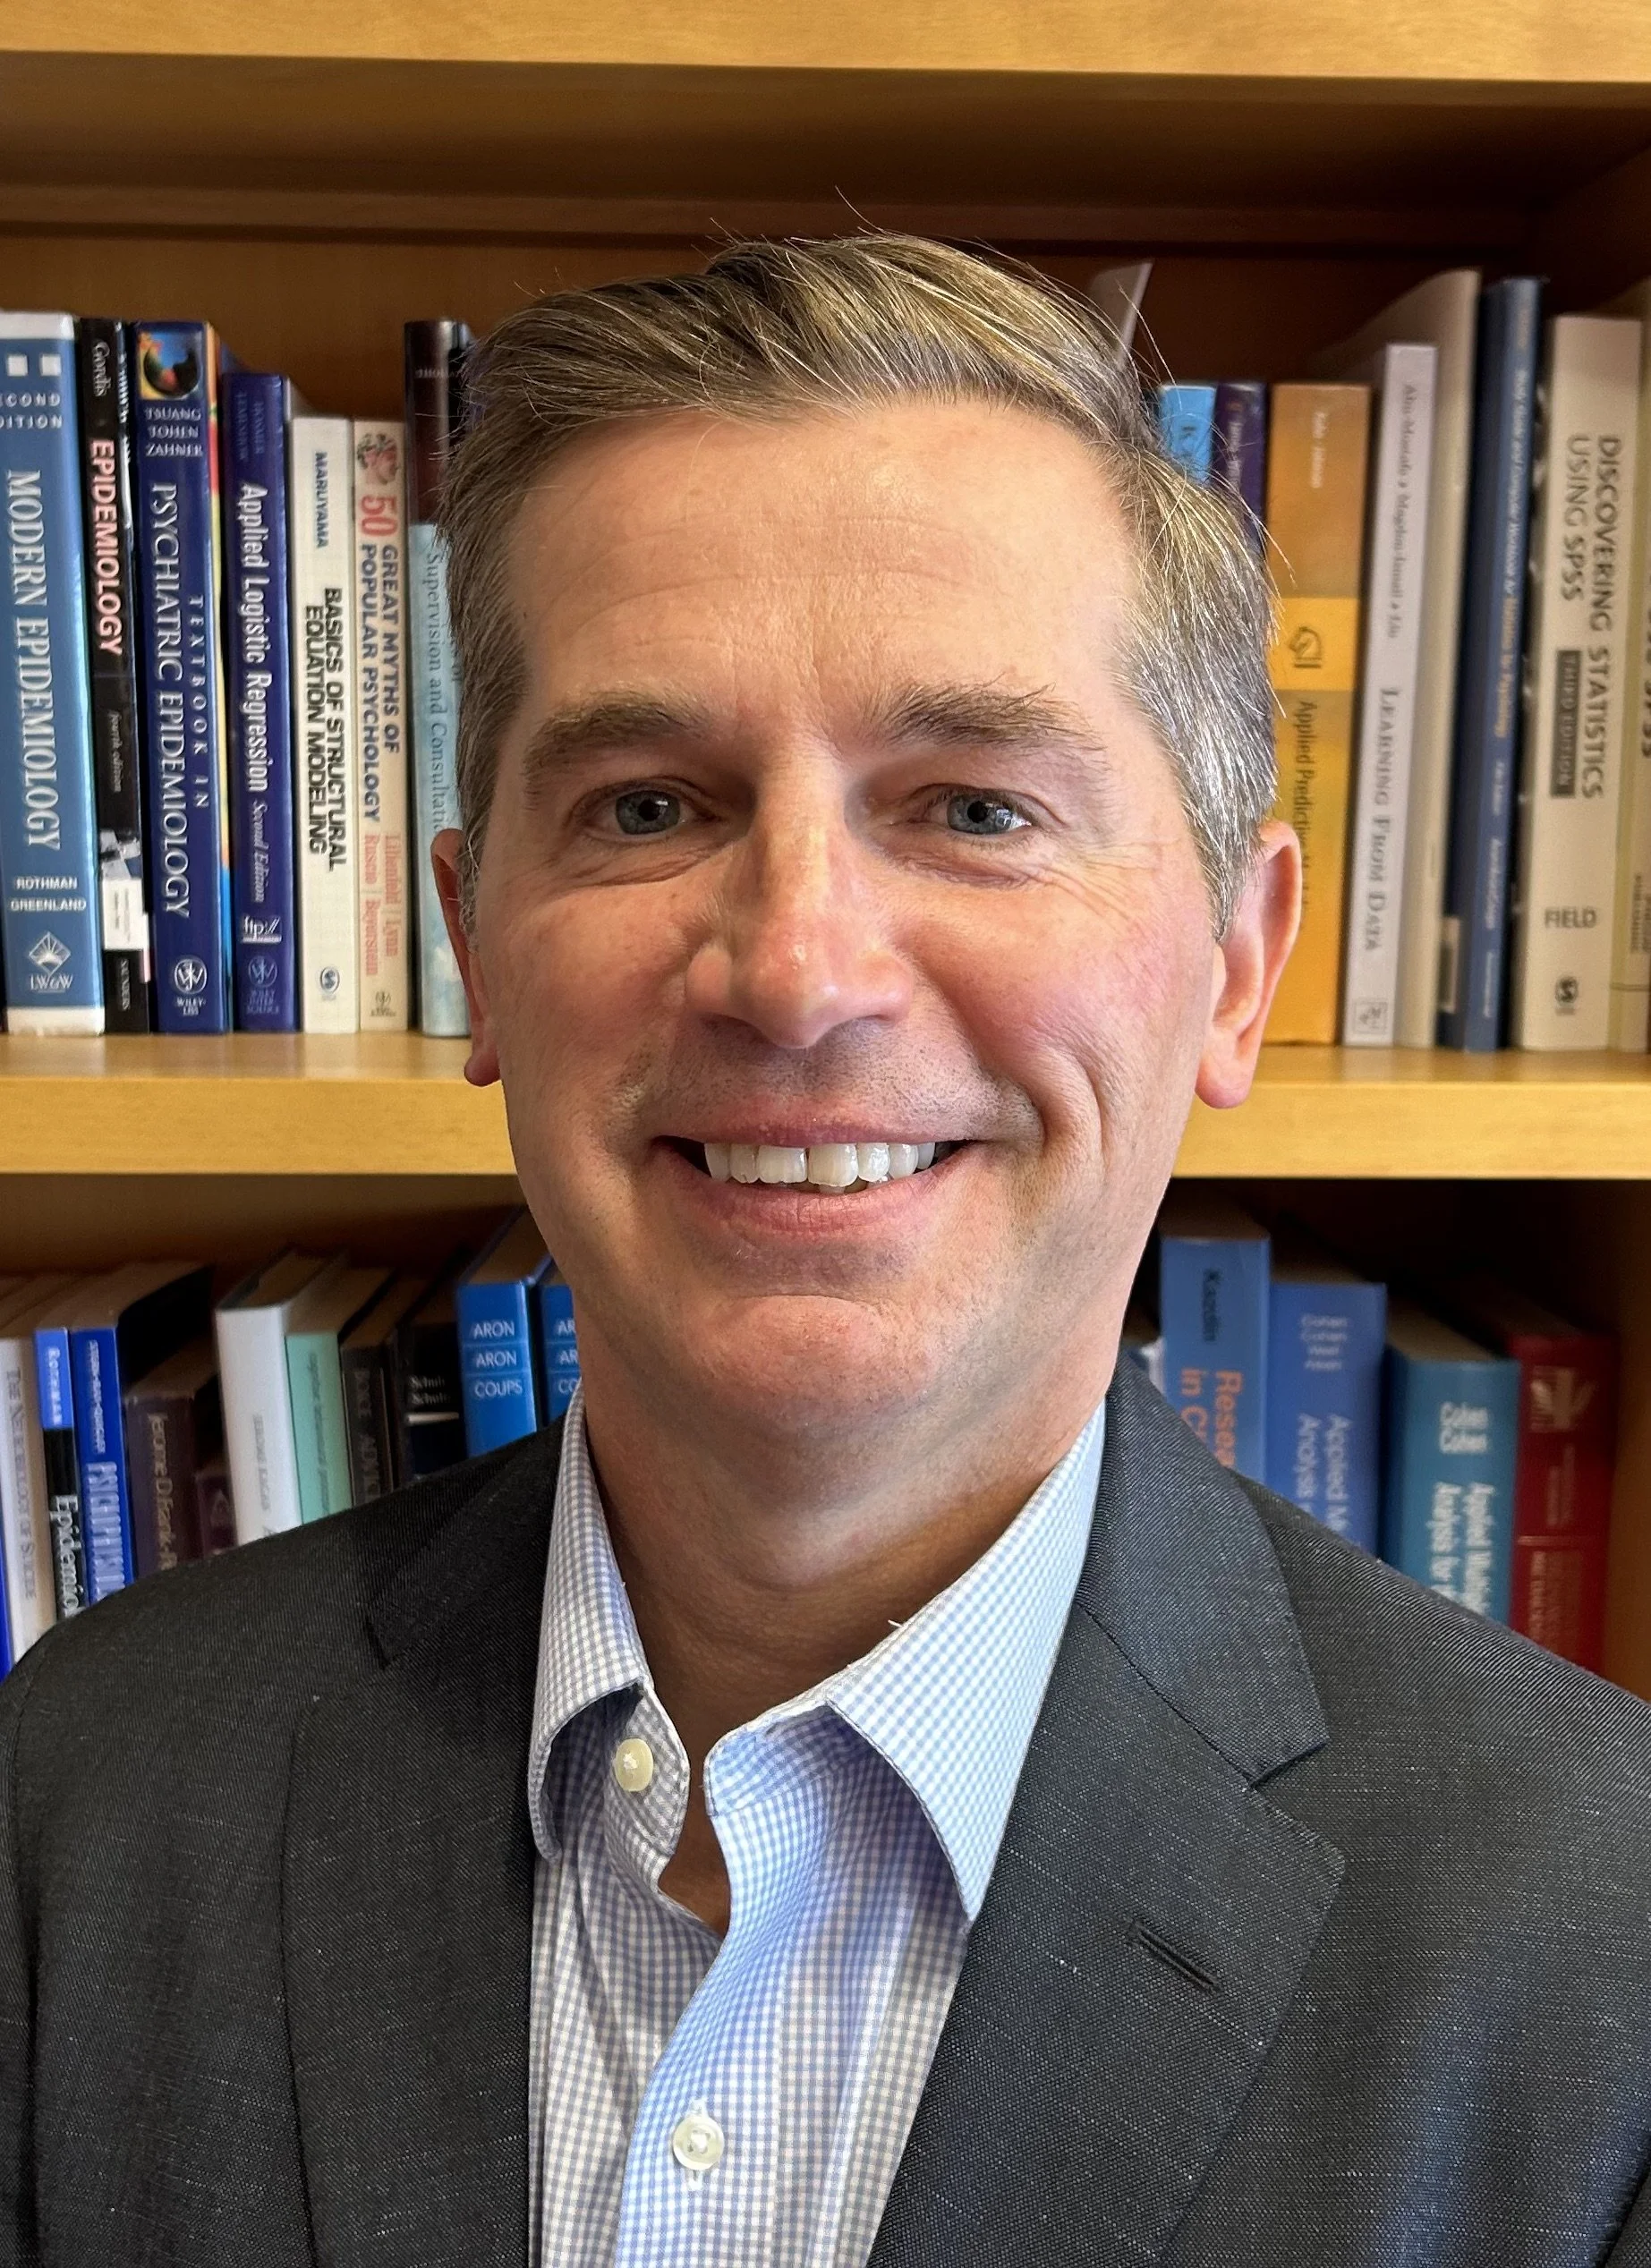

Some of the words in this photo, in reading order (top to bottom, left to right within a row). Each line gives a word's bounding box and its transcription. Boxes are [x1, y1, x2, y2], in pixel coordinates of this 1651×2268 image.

[0, 393, 61, 407] COND
[91, 340, 112, 396] Gordis
[315, 452, 329, 548] MARUYAMA
[361, 495, 397, 536] 50
[1564, 436, 1592, 528] USING
[7, 469, 47, 606] MODERN
[89, 438, 123, 655] EPIDEMIOLOGY
[237, 483, 270, 567] Applied
[1589, 436, 1622, 632] DISCOVERING
[151, 482, 183, 681] PSYCHIATRIC
[361, 544, 379, 659] POPULAR
[381, 544, 399, 624] GREAT
[1562, 535, 1587, 602] SPSS
[239, 577, 271, 663] Logistic
[324, 588, 344, 673] BASICS
[424, 553, 446, 671] Supervision
[189, 594, 208, 754] TEXTBOOK
[306, 605, 326, 724] EQUATION
[326, 681, 345, 712] OF
[382, 633, 400, 716] MYTHS
[429, 678, 447, 714] and
[15, 616, 60, 850] EPIDEMIOLOGY
[240, 671, 273, 791] Regression
[362, 667, 380, 822] PSYCHOLOGY
[383, 724, 400, 753] OF
[1294, 701, 1318, 764] Applied
[1557, 715, 1576, 786] EDITION
[1581, 646, 1612, 799] STATISTICS
[112, 751, 125, 793] edition
[158, 690, 190, 918] EPIDEMIOLOGY
[194, 775, 209, 809] IN
[308, 731, 328, 854] MODELING
[327, 718, 347, 872] STRUCTURAL
[252, 801, 268, 847] Second
[11, 898, 87, 911] GREENLAND
[16, 877, 78, 889] ROTHMAN
[253, 850, 270, 903] Edition
[1366, 892, 1386, 952] DATA
[1545, 905, 1597, 929] FIELD
[472, 1321, 515, 1338] ARON
[475, 1350, 517, 1368] ARON
[474, 1379, 523, 1398] COUPS
[1180, 1369, 1207, 1397] in
[147, 1412, 169, 1476] Jerome
[1295, 1413, 1321, 1499] Analysis
[1324, 1414, 1351, 1500] Applied
[1426, 1482, 1462, 1553] Analysis
[1463, 1482, 1495, 1548] Applied
